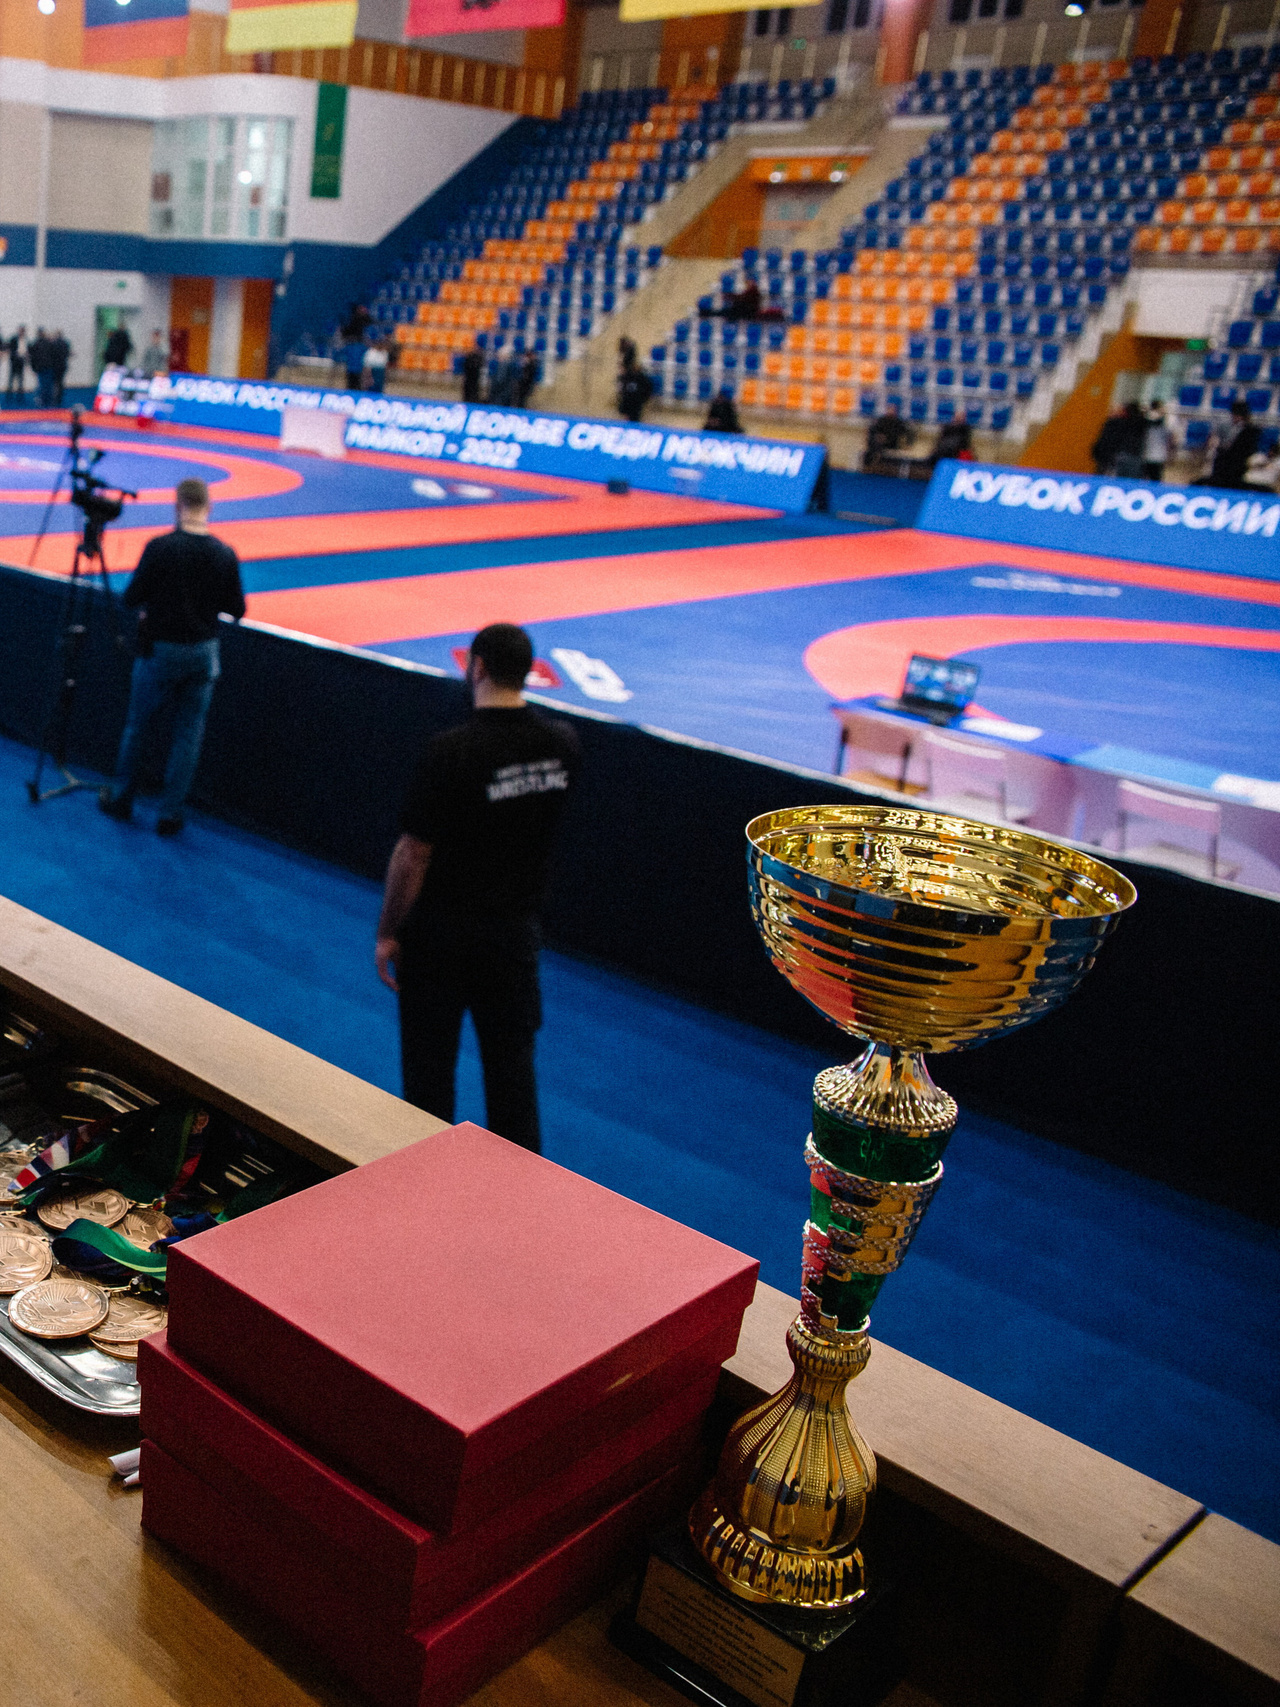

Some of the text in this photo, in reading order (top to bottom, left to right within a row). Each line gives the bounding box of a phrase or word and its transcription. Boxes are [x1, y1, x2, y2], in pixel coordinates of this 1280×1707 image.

[175, 377, 239, 406] КУБОК
[235, 383, 321, 412] РОССИИ
[352, 397, 468, 435] ВОЛЬНОЙ
[465, 409, 569, 448] БОРЬБЕ
[567, 422, 664, 461] СРЕДИ
[661, 433, 805, 478] МУЖЧИН
[344, 423, 447, 459] МАЙКОП
[457, 437, 523, 470] 2022
[948, 467, 1280, 538] КУБОК РОССИИ
